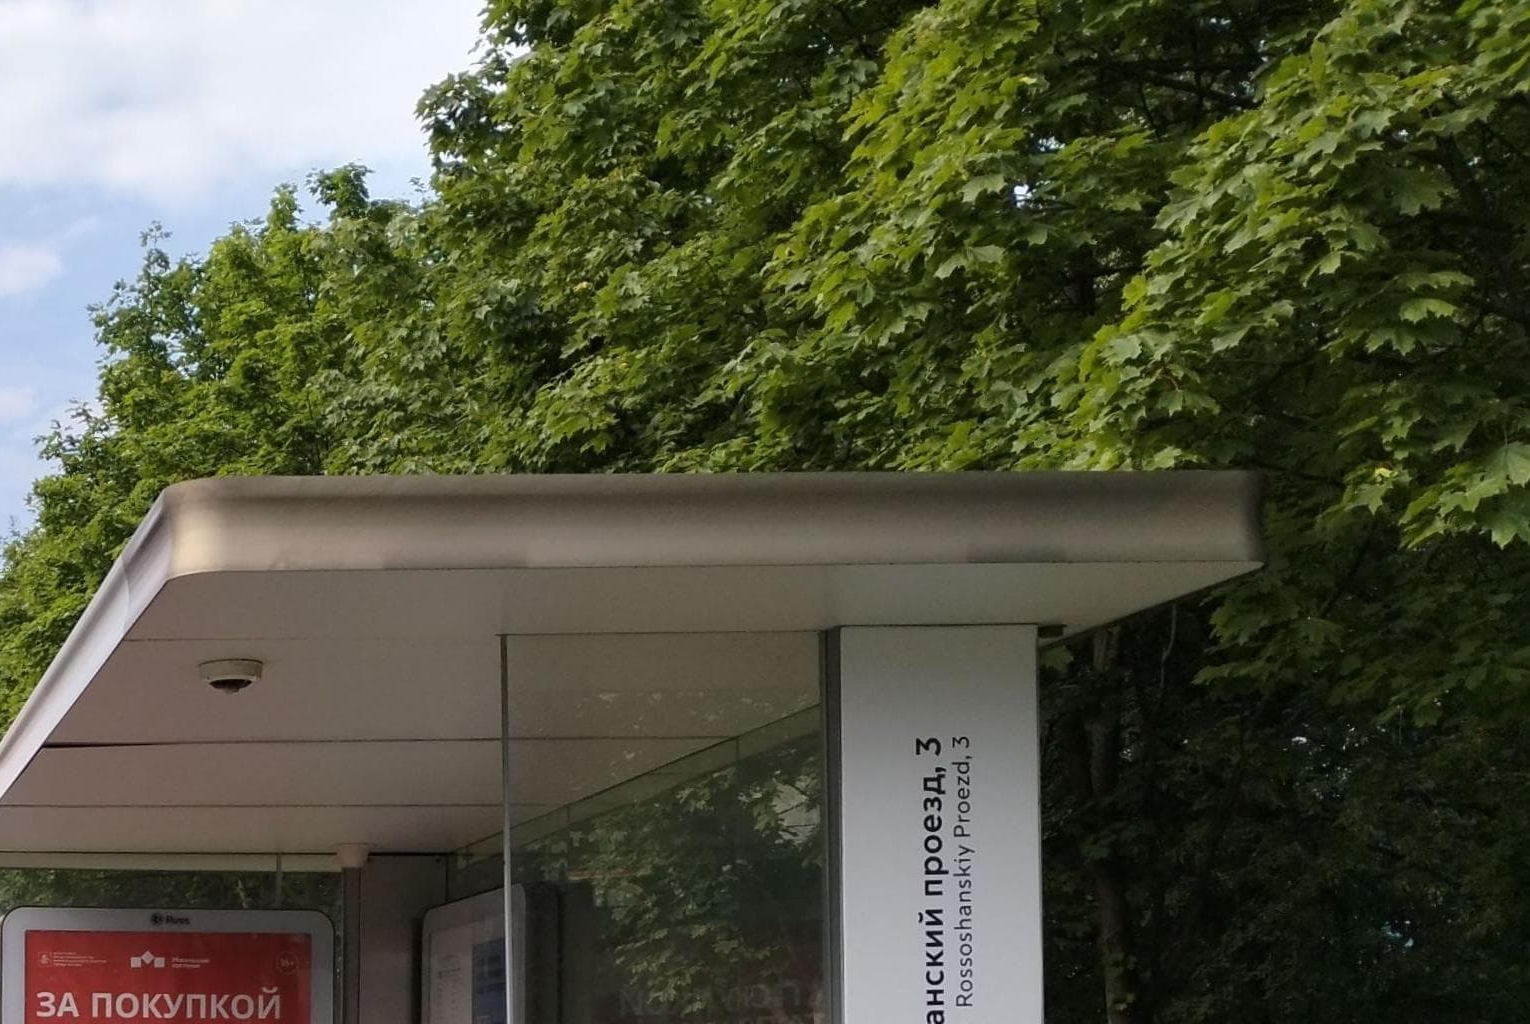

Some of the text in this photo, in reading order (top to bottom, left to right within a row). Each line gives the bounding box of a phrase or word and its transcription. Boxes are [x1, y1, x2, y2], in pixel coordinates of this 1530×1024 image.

[916, 737, 941, 757] 3
[923, 766, 949, 896] проезд,
[951, 735, 975, 1008] Rossoshanskiy Proezd, 3
[36, 986, 281, 1020] ЗА ПОКУПКОЙ
